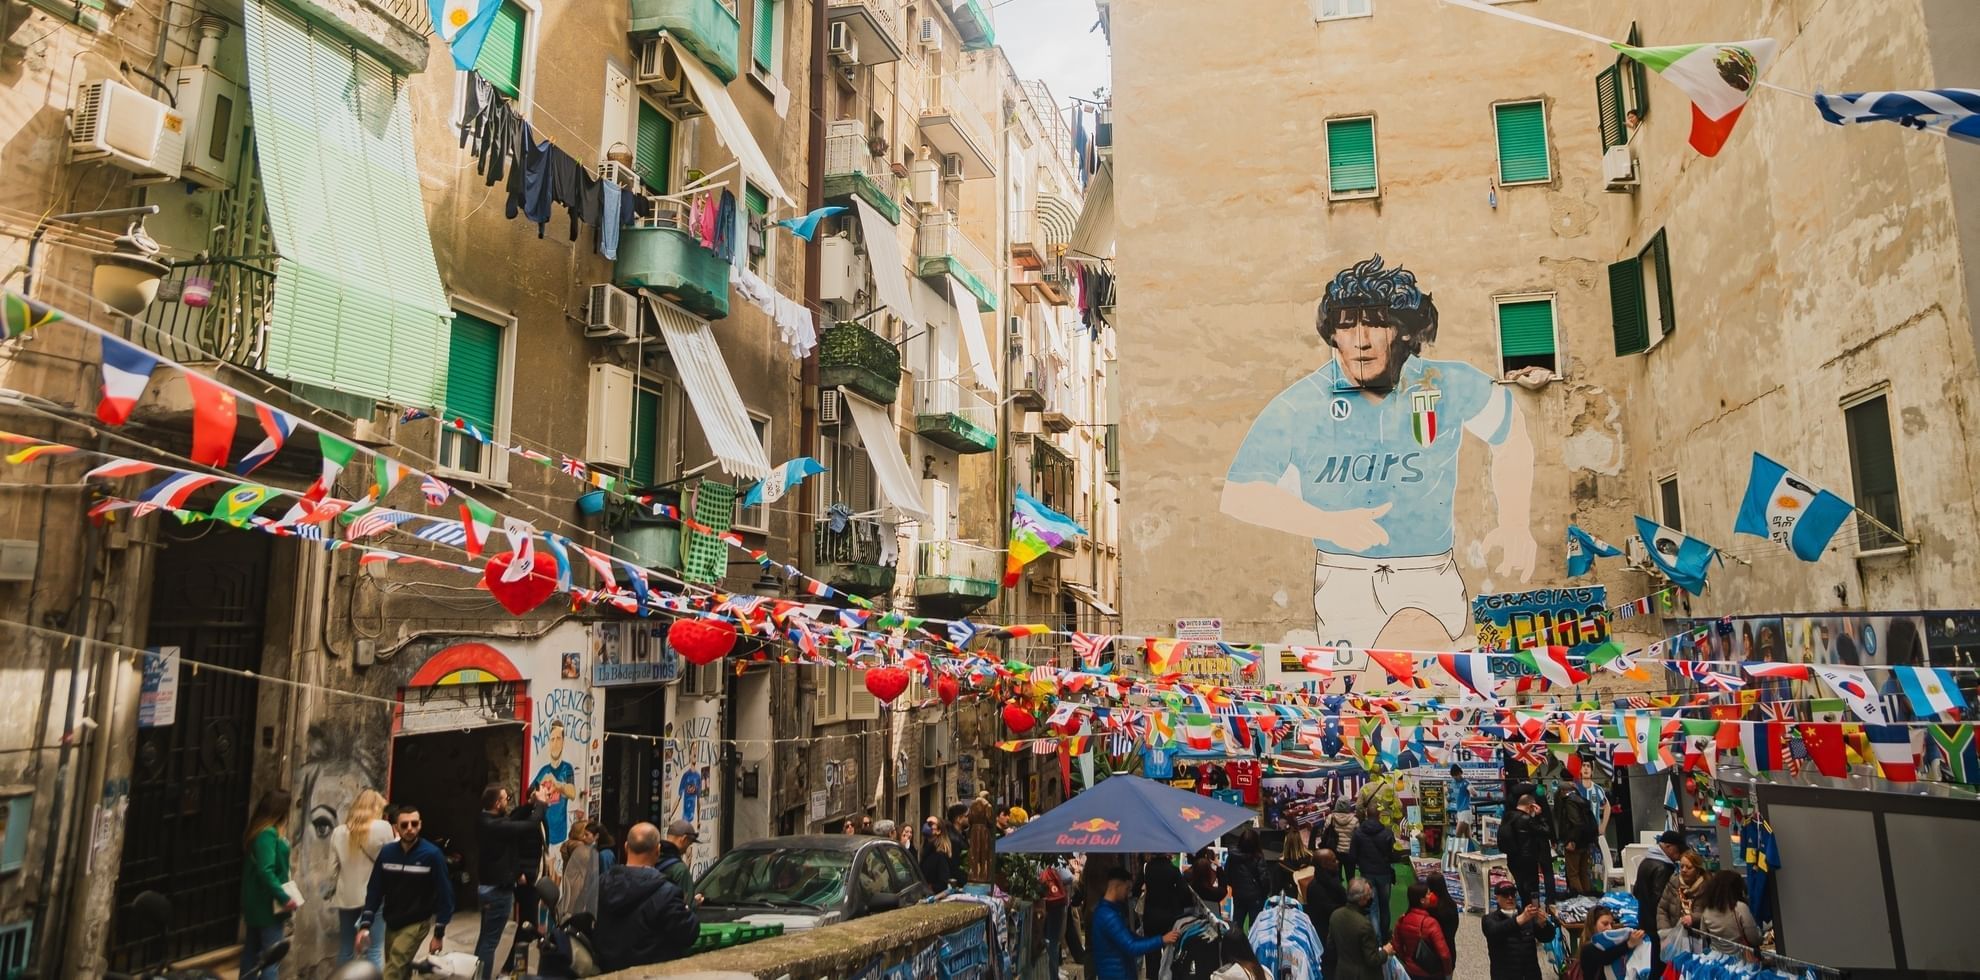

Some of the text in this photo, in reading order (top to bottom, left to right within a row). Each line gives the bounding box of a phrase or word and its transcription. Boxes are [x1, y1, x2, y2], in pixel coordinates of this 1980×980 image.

[1486, 588, 1593, 609] GRACIAS
[630, 627, 648, 661] 10
[611, 664, 641, 681] Bodega
[642, 668, 651, 679] de
[536, 688, 595, 728] LORENZO
[672, 739, 719, 777] METENS
[1152, 749, 1164, 763] 10
[1055, 832, 1122, 846] Red Bull
